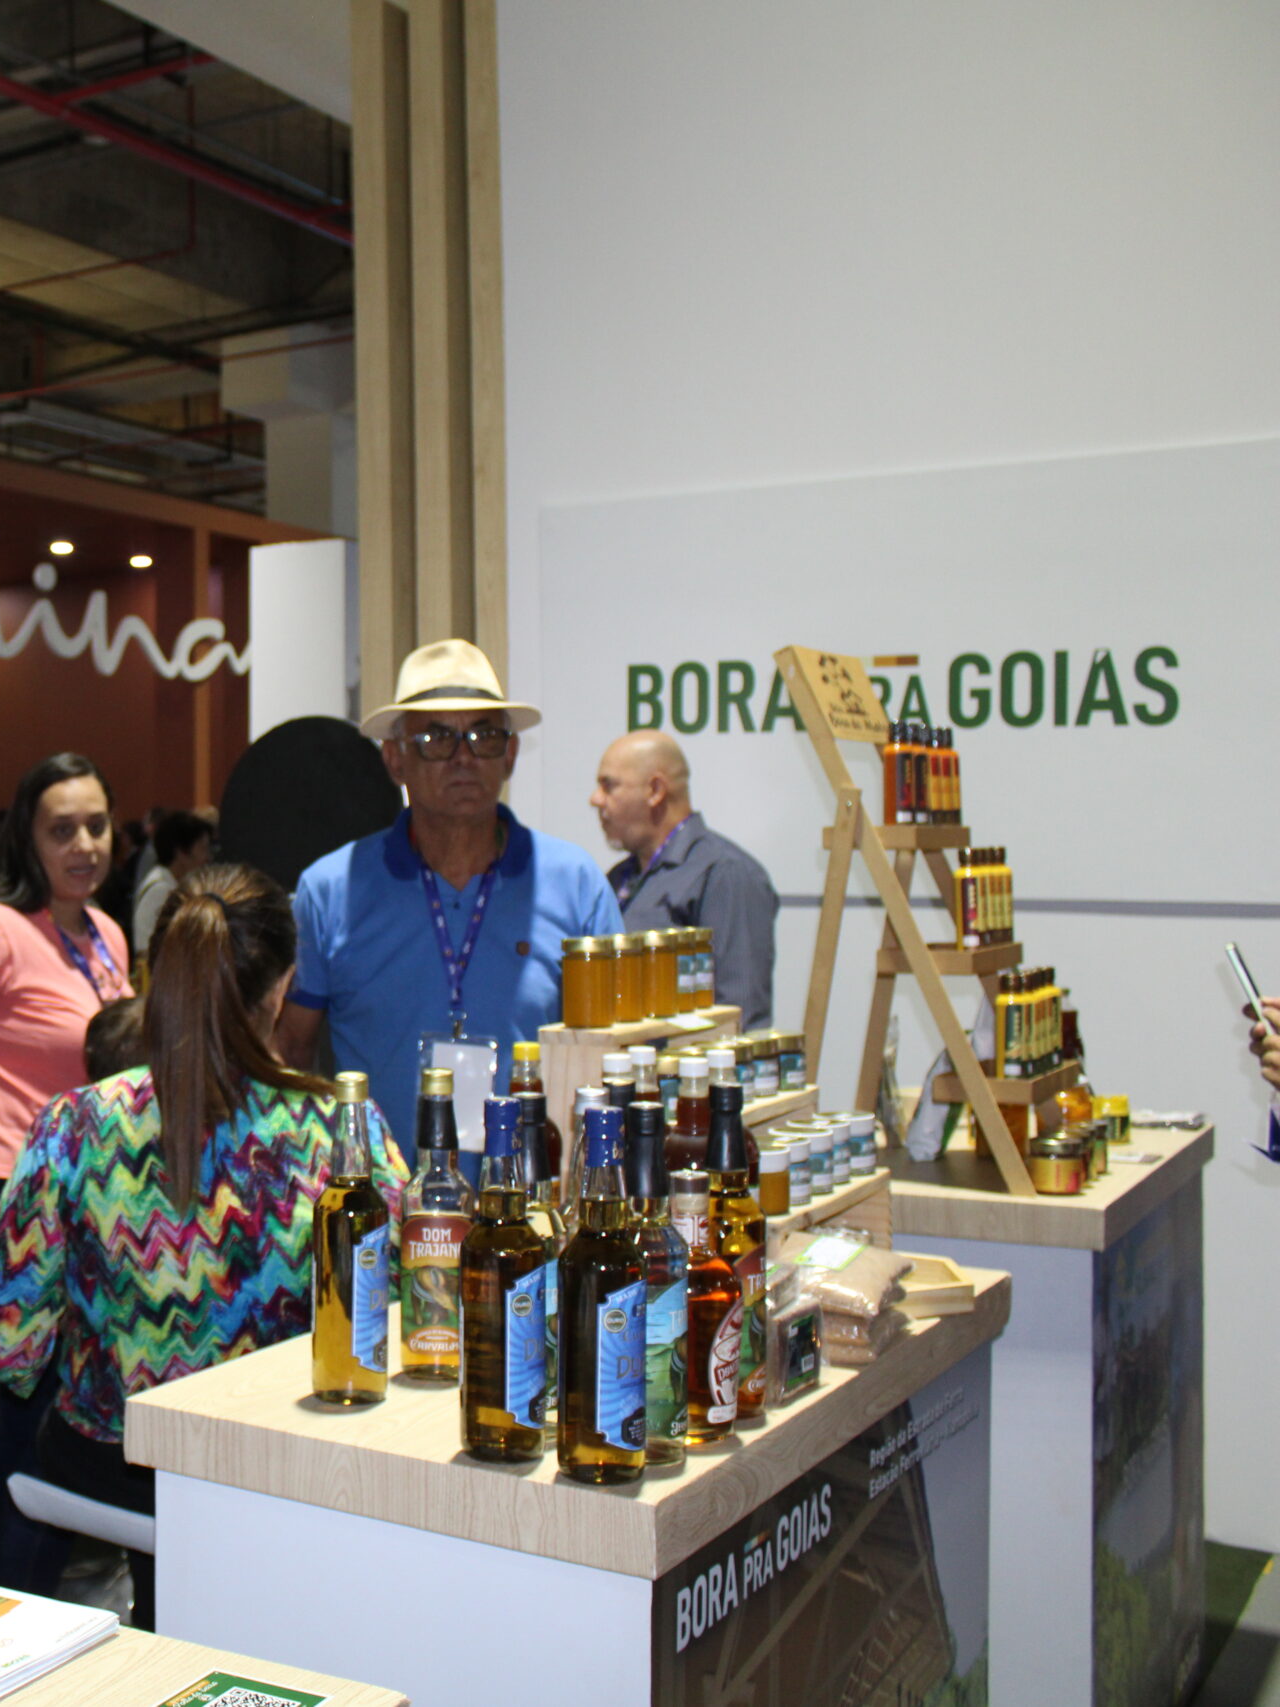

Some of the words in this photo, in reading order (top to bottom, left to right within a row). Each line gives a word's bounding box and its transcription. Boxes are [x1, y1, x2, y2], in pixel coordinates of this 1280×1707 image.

[628, 660, 808, 734] BORA
[868, 674, 932, 727] RA
[408, 1240, 461, 1260] TRAJAN
[422, 1227, 452, 1242] DOM
[676, 1552, 739, 1653] BORA
[743, 1541, 773, 1600] PRA
